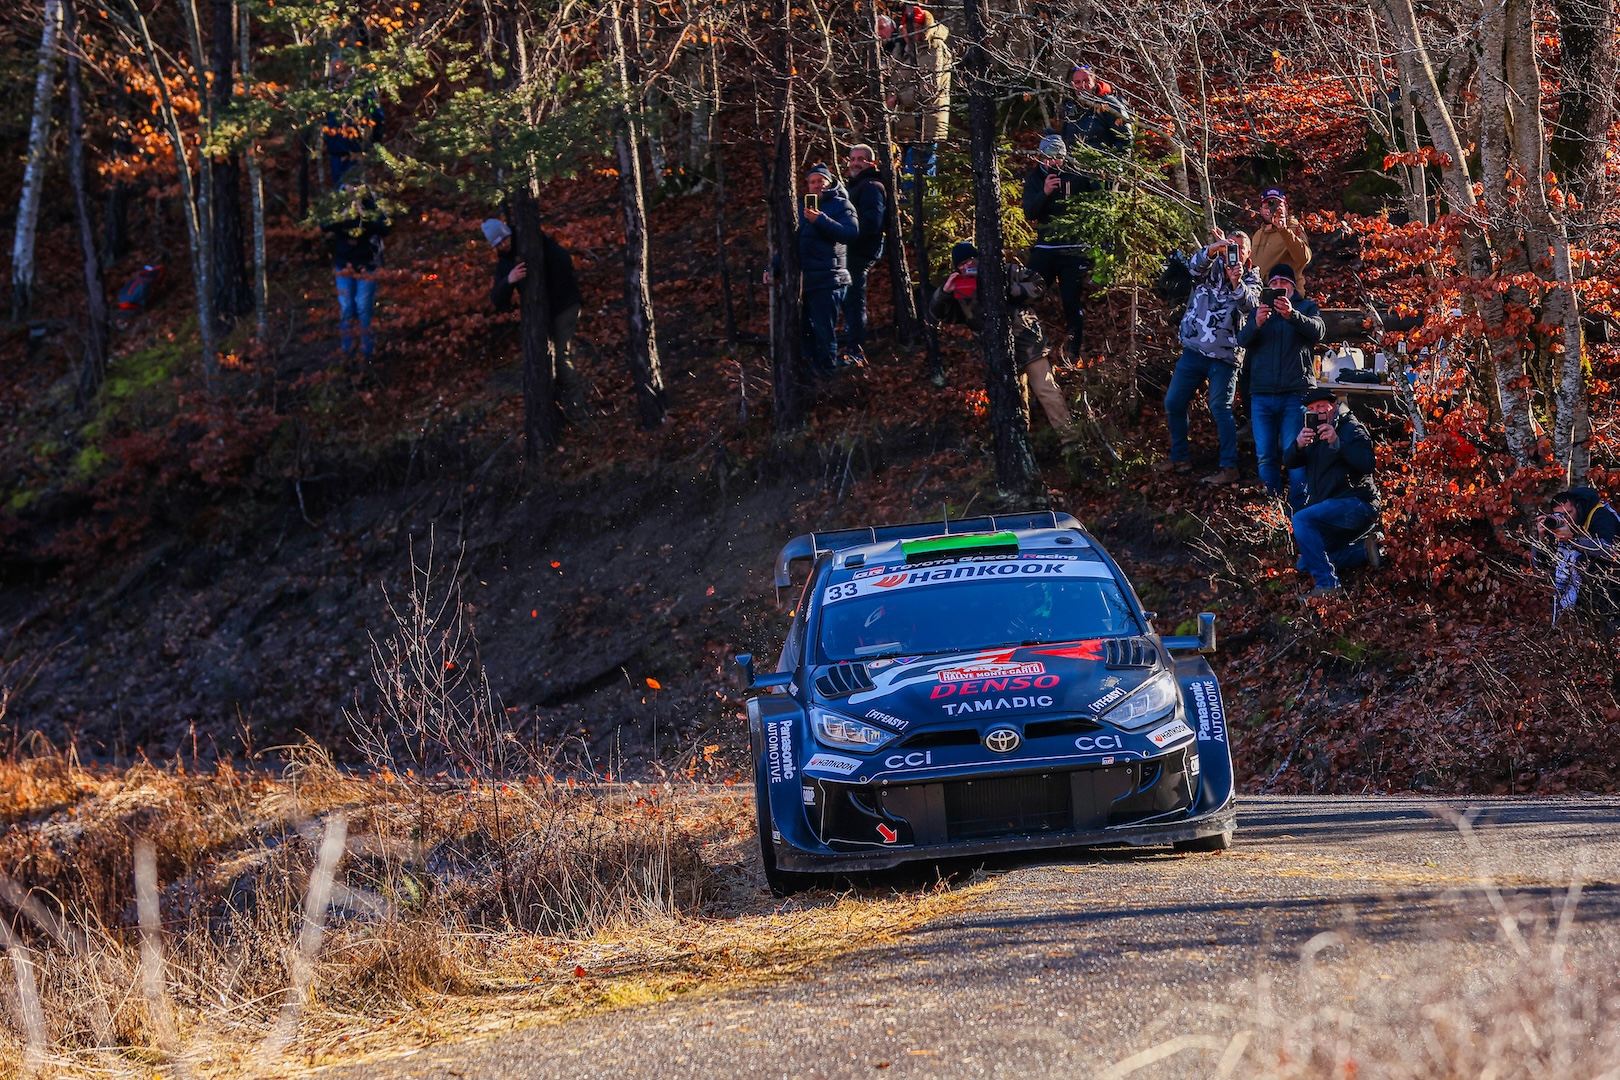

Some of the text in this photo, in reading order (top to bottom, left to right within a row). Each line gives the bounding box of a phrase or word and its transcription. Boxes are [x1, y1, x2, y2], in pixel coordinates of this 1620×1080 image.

[889, 553, 1078, 572] TOYOTA GAZOO Racing
[828, 582, 858, 601] 33
[929, 674, 1061, 700] DENSO
[944, 672, 975, 681] RALLYE
[941, 695, 1054, 716] TAMADIC
[1189, 681, 1212, 741] Panasonic
[1202, 680, 1225, 743] AUTOMOTIVE
[767, 721, 782, 784] AUTOMOTIVE
[779, 719, 797, 780] Panasonic
